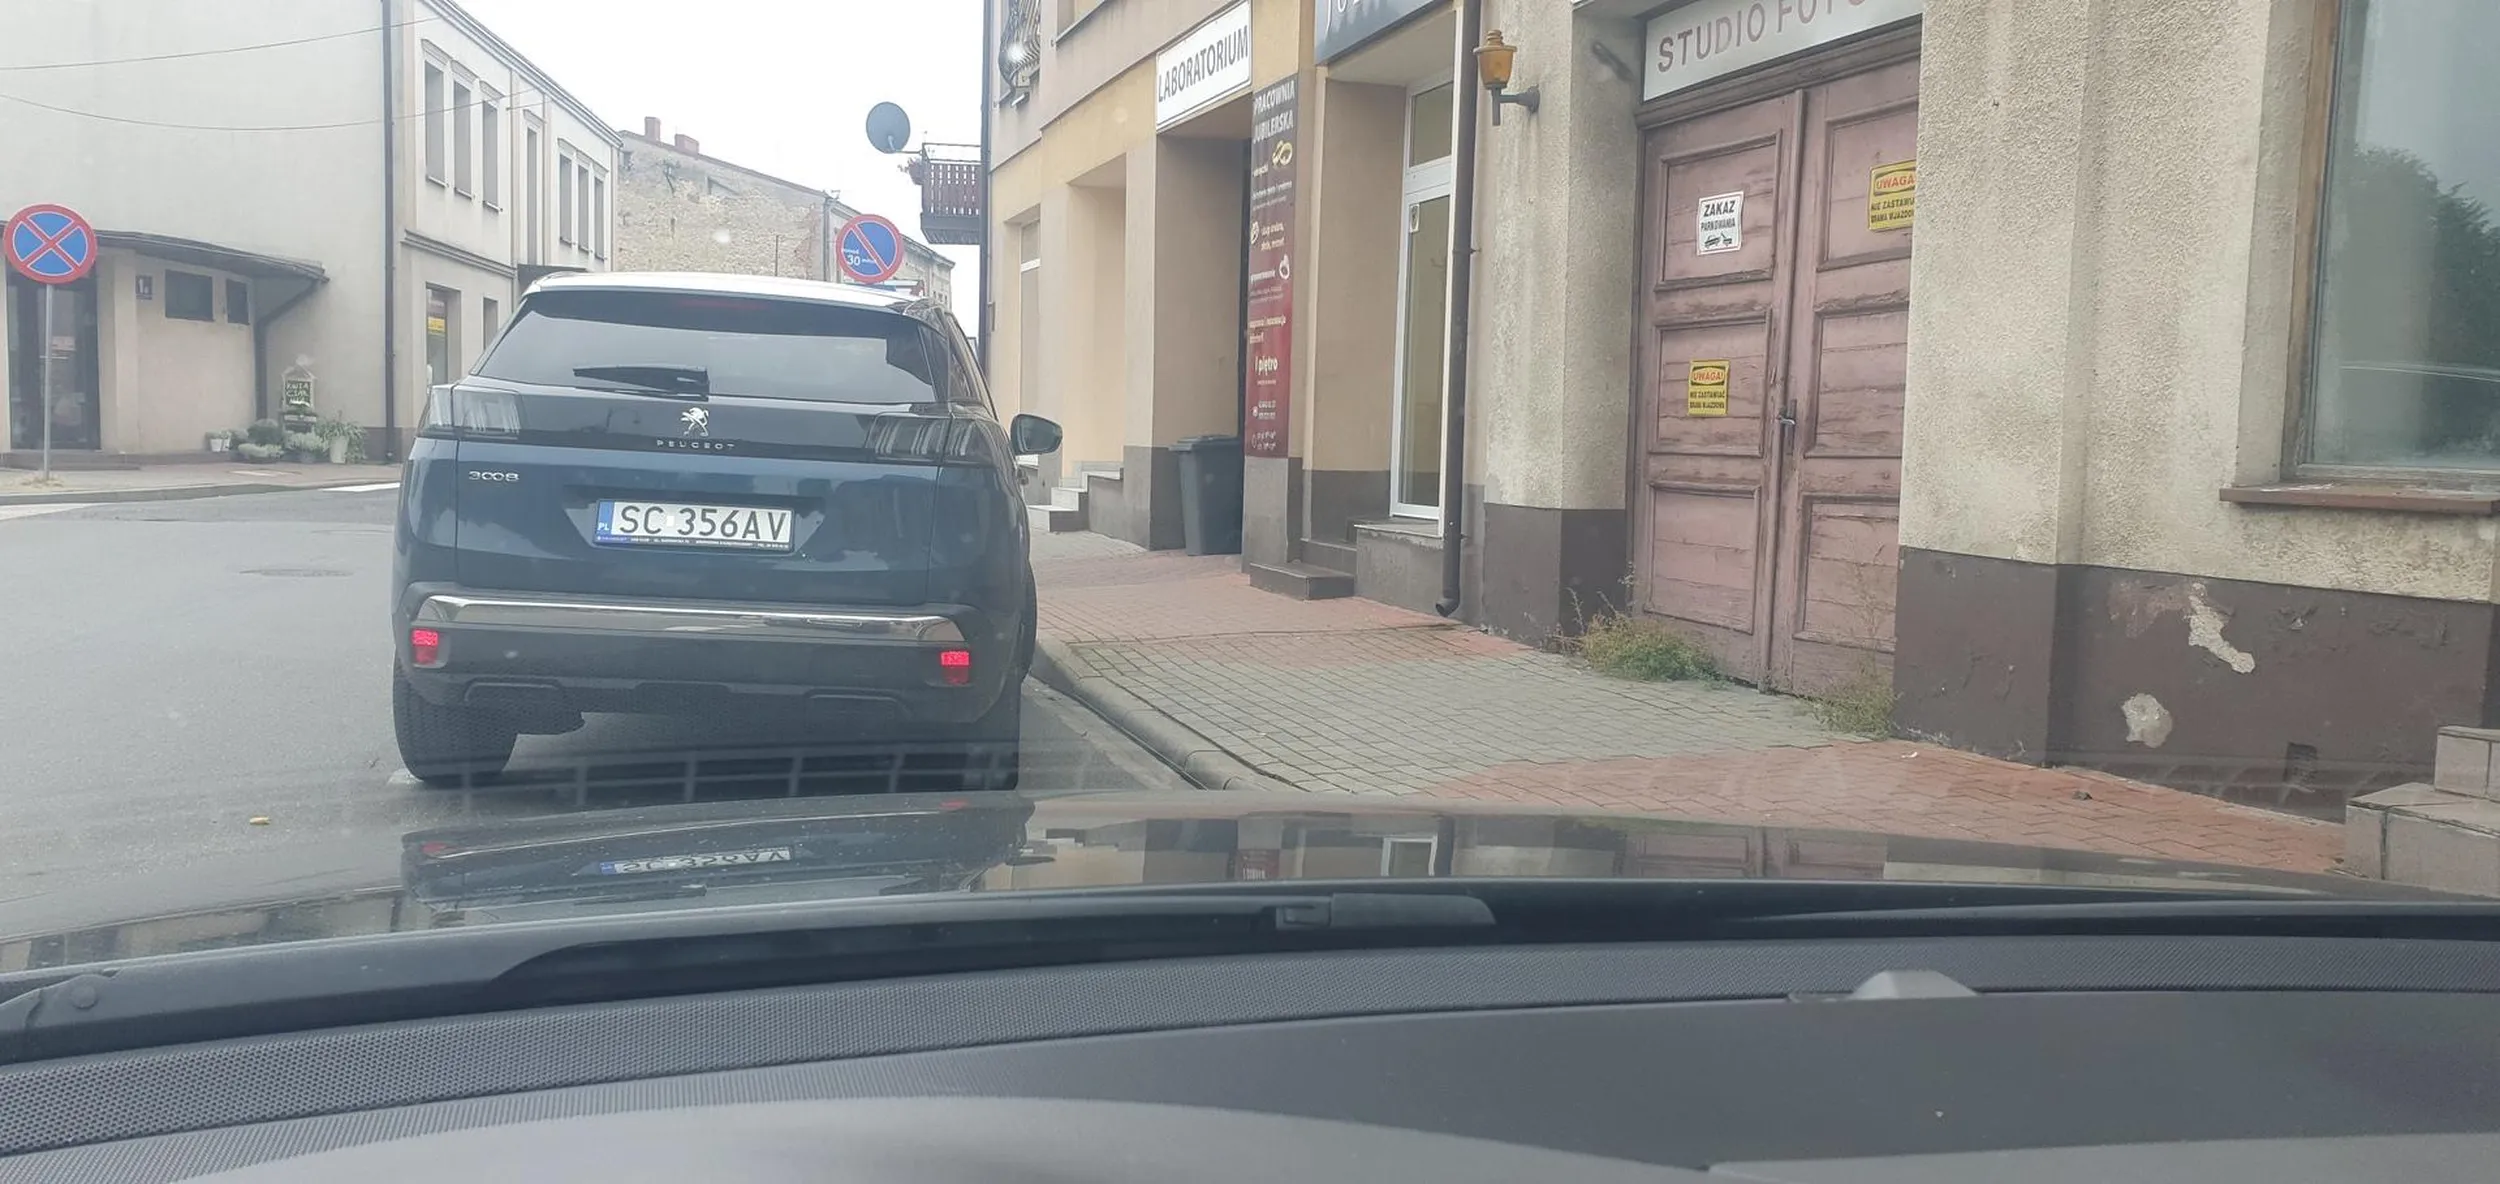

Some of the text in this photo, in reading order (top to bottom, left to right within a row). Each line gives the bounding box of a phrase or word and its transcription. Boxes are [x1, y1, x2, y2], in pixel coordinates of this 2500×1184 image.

[1657, 0, 1861, 73] STUDIO FO
[1158, 24, 1248, 103] LABORATORIUM
[1253, 79, 1296, 116] PRACOWNIA
[1252, 109, 1294, 145] JUBILERSKA
[1703, 200, 1736, 217] ZAKAZ
[847, 254, 861, 266] 30
[1259, 355, 1279, 377] piętro
[1693, 370, 1725, 381] UWAGA!
[656, 439, 736, 450] PEUGEOT
[468, 469, 521, 483] 3008
[597, 521, 610, 531] PL
[620, 505, 788, 542] SC 356AV
